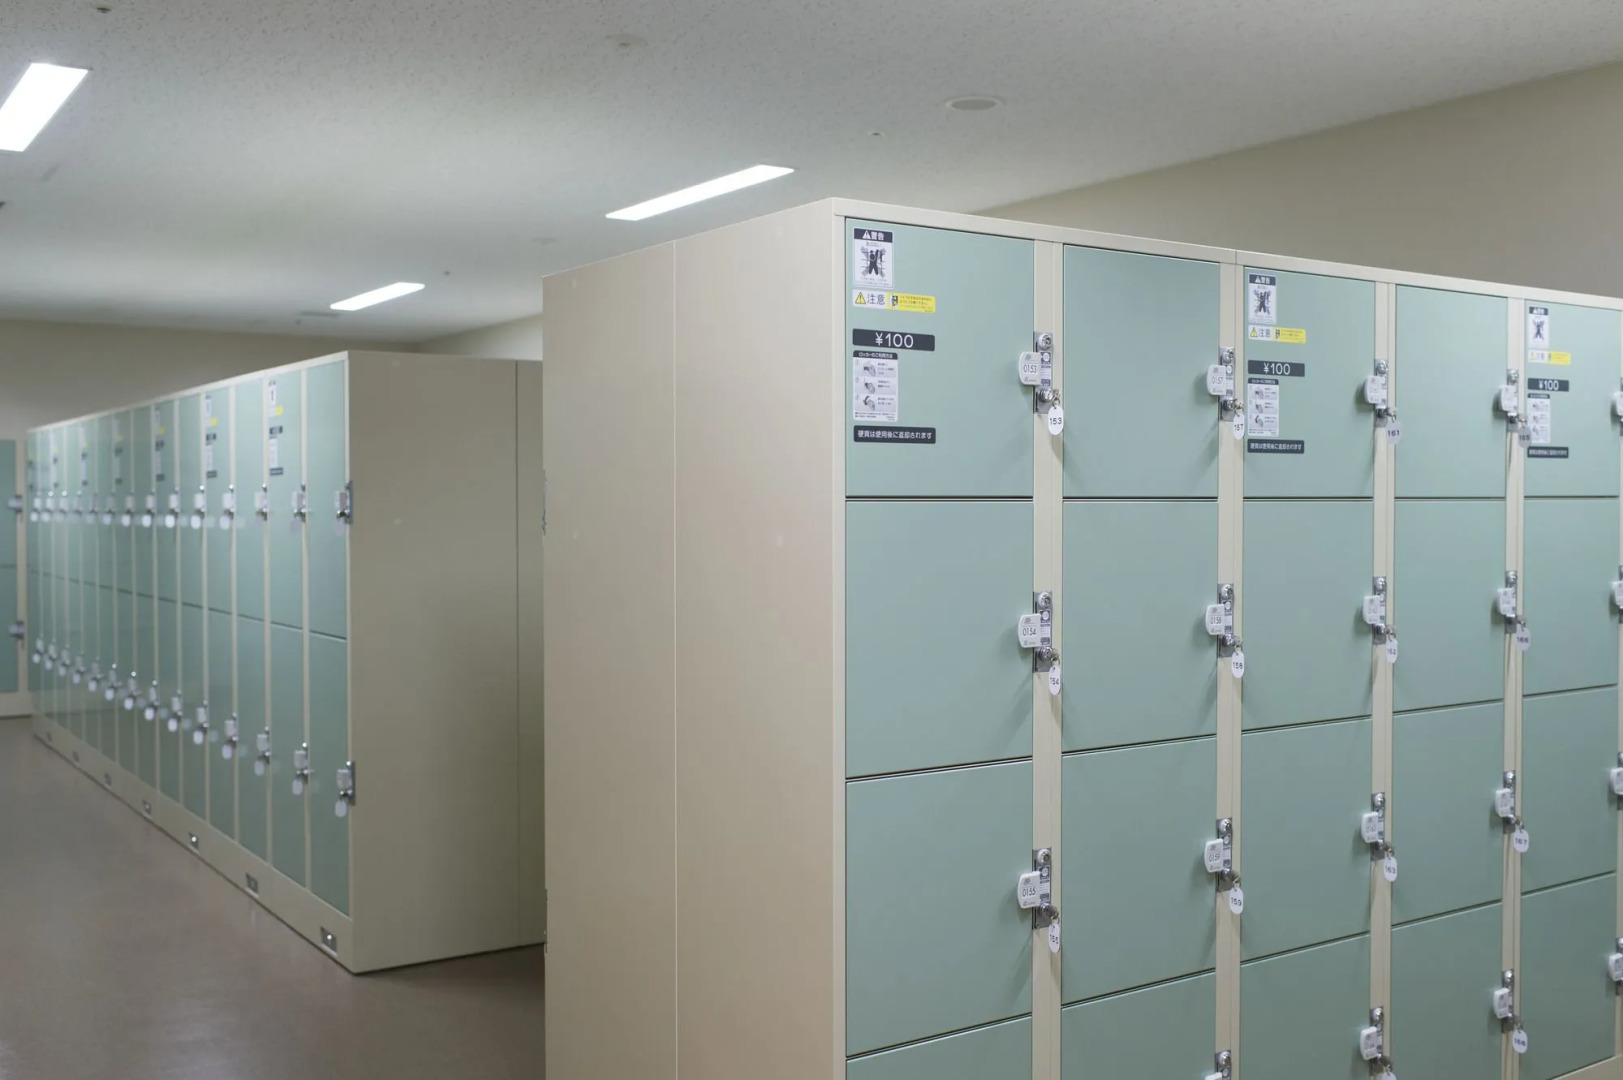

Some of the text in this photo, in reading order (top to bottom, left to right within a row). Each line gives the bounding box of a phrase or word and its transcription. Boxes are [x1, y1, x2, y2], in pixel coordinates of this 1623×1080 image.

[867, 293, 886, 305] 注意
[875, 331, 914, 348] ¥100
[1023, 364, 1037, 374] 0153
[1263, 362, 1291, 375] ¥100
[1049, 417, 1062, 425] 153
[1234, 423, 1244, 431] 157
[1387, 429, 1400, 437] 161
[1022, 627, 1036, 637] 0154
[1232, 661, 1243, 670] 158
[1049, 676, 1059, 685] 154
[1022, 886, 1036, 897] 0155
[1230, 896, 1242, 906] 159
